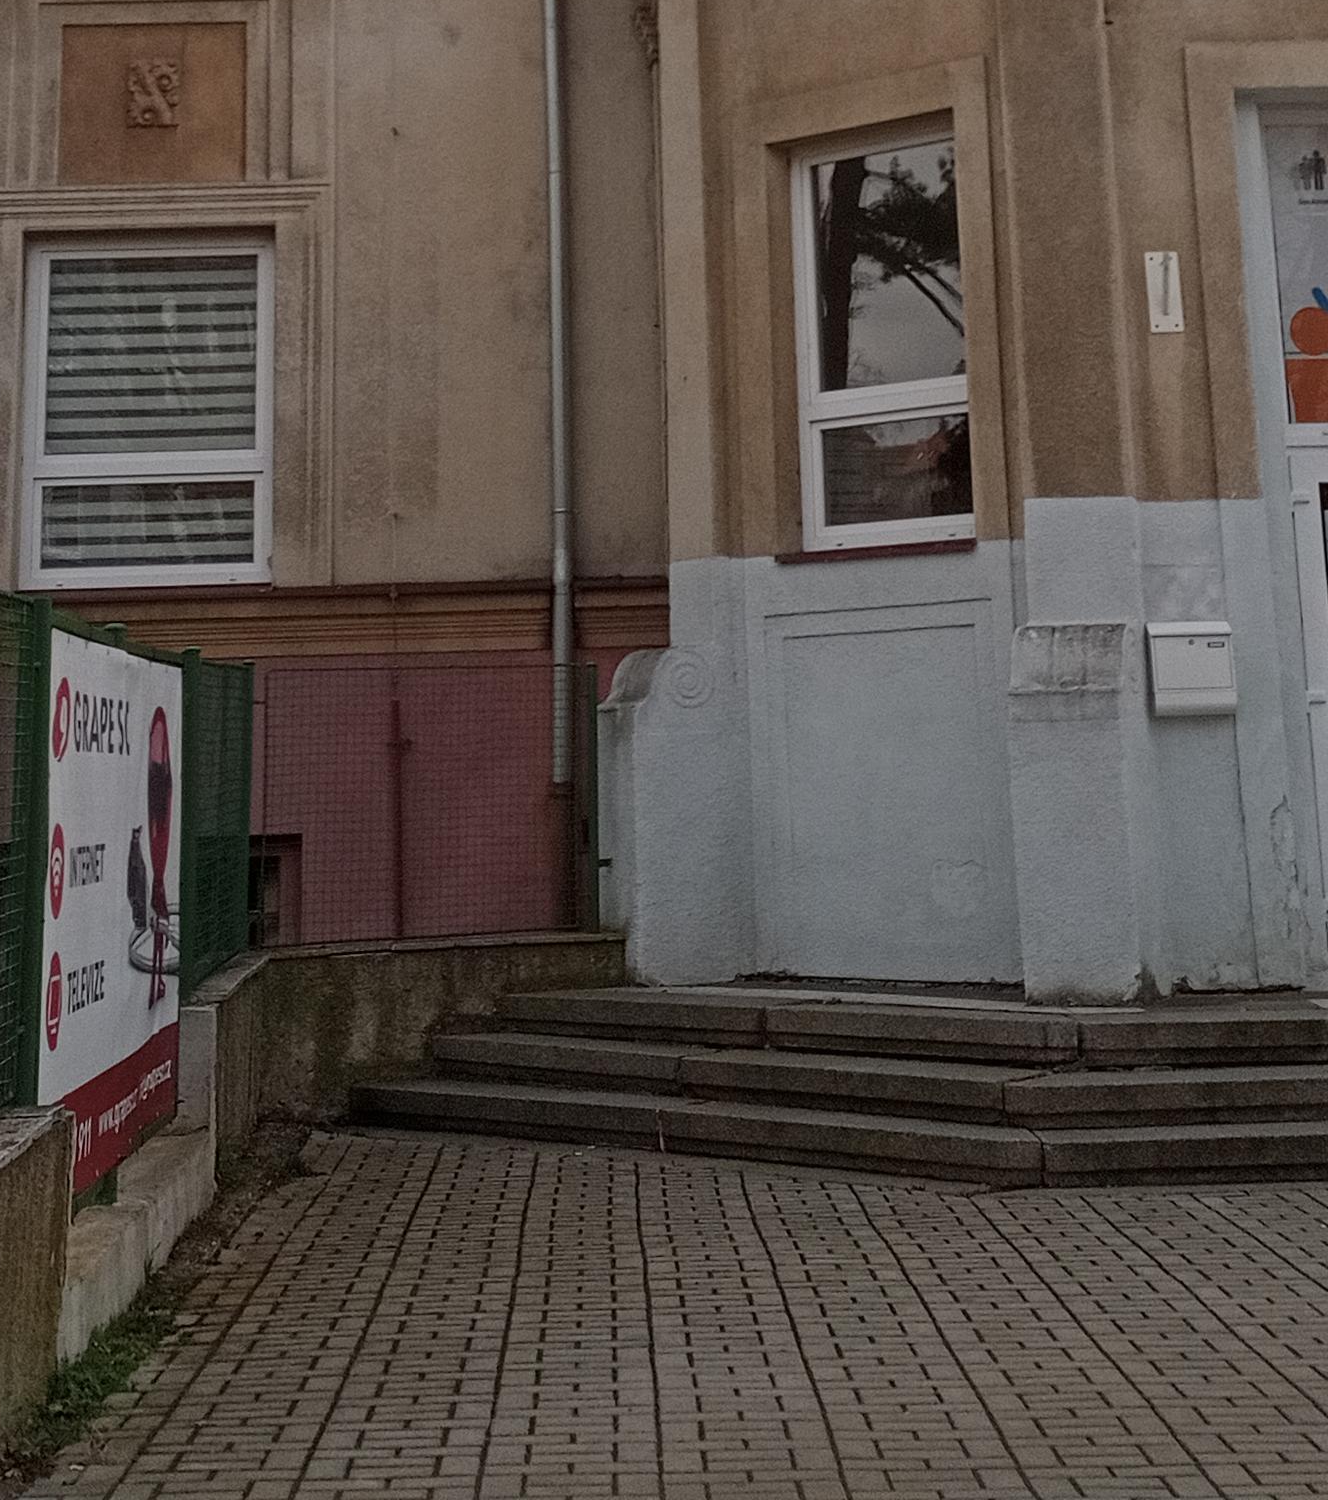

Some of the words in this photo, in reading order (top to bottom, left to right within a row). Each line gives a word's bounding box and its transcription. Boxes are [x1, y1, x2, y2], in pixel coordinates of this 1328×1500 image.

[74, 690, 115, 754] GRAPE
[69, 843, 106, 888] INTERNET
[67, 959, 105, 1016] TELEVIZE
